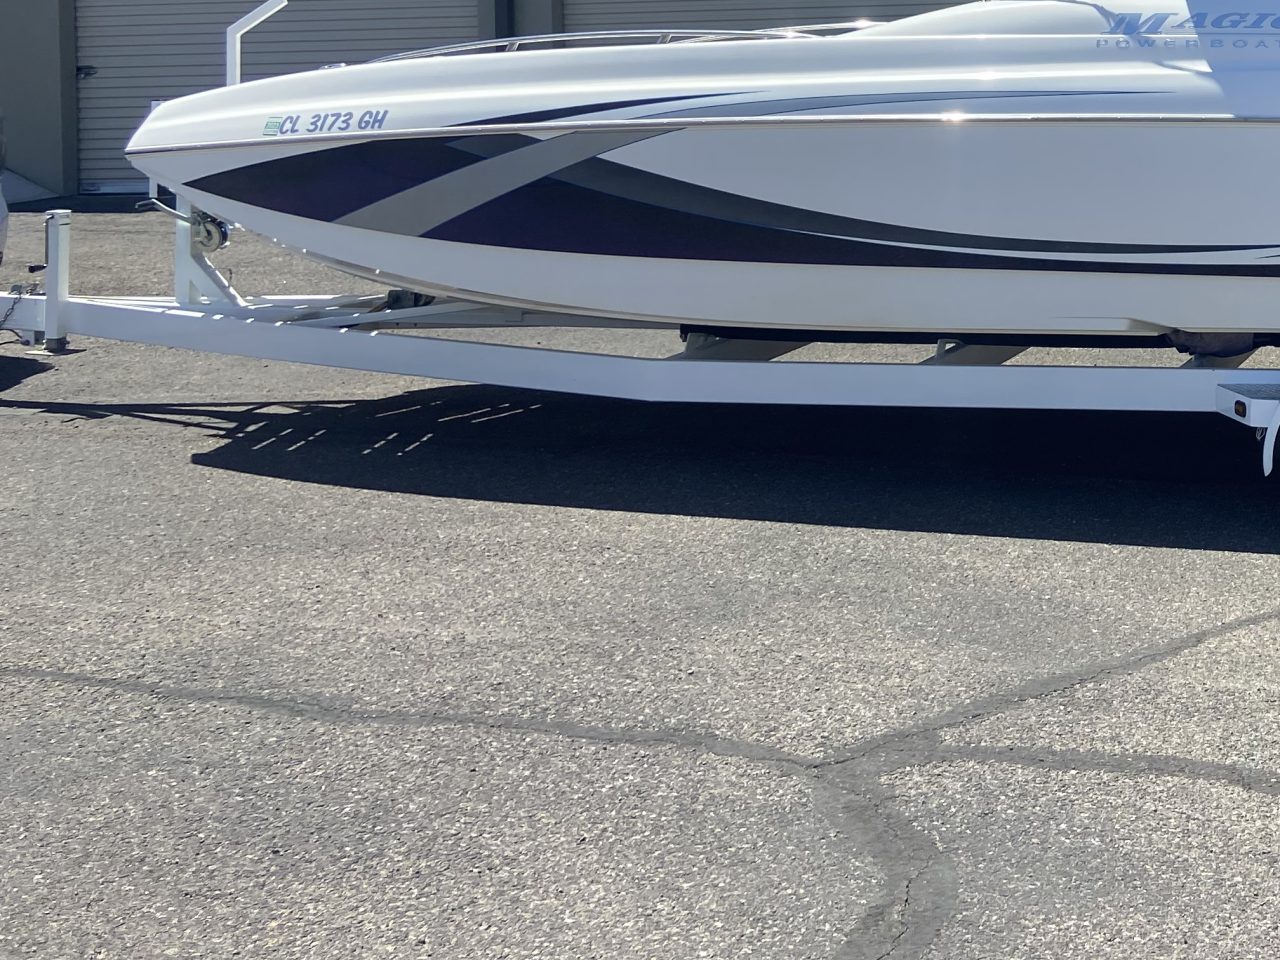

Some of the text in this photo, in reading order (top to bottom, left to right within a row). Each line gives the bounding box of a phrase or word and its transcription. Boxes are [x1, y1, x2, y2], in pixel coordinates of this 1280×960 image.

[280, 109, 389, 134] CL 3173 GH
